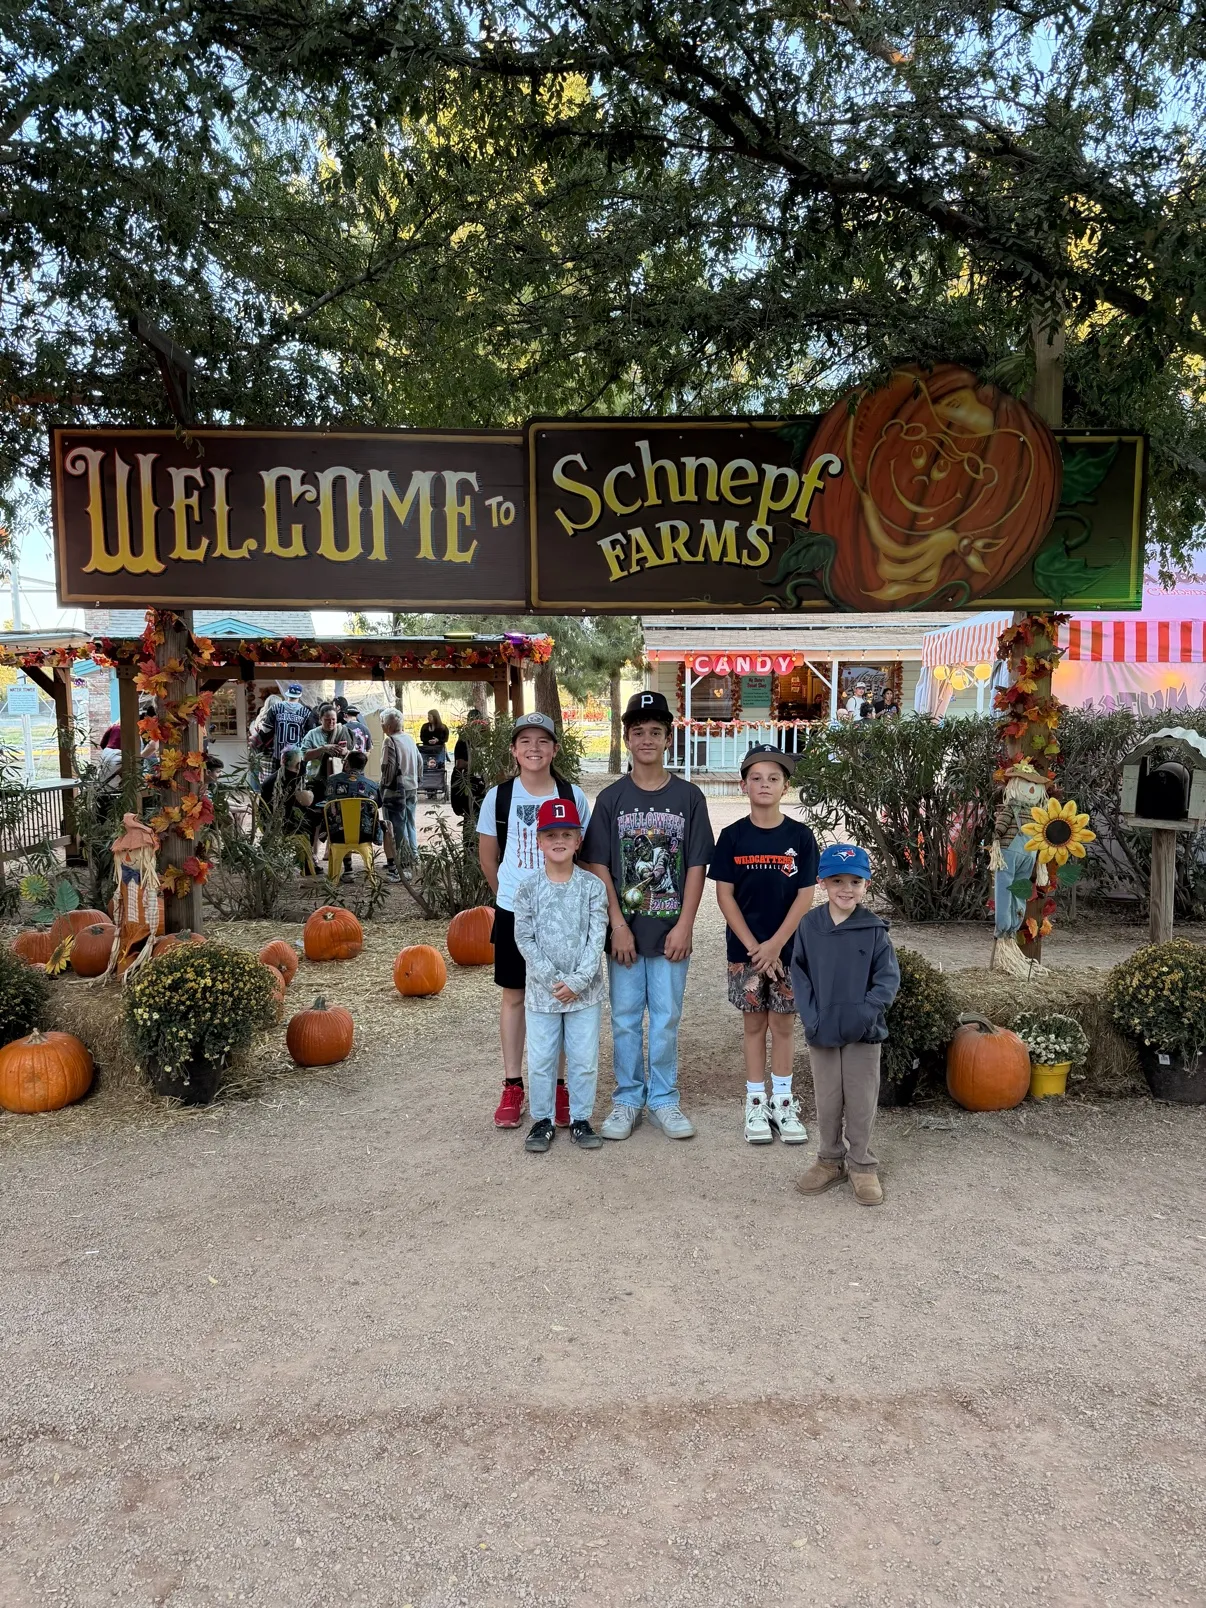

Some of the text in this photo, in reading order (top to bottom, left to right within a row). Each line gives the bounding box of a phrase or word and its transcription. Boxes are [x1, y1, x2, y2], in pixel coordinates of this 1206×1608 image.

[552, 439, 842, 536] Schnepf
[66, 446, 480, 575] WELCOME
[597, 519, 774, 582] FARMS
[694, 656, 792, 673] CANDY
[641, 694, 654, 708] P
[278, 721, 300, 745] 10
